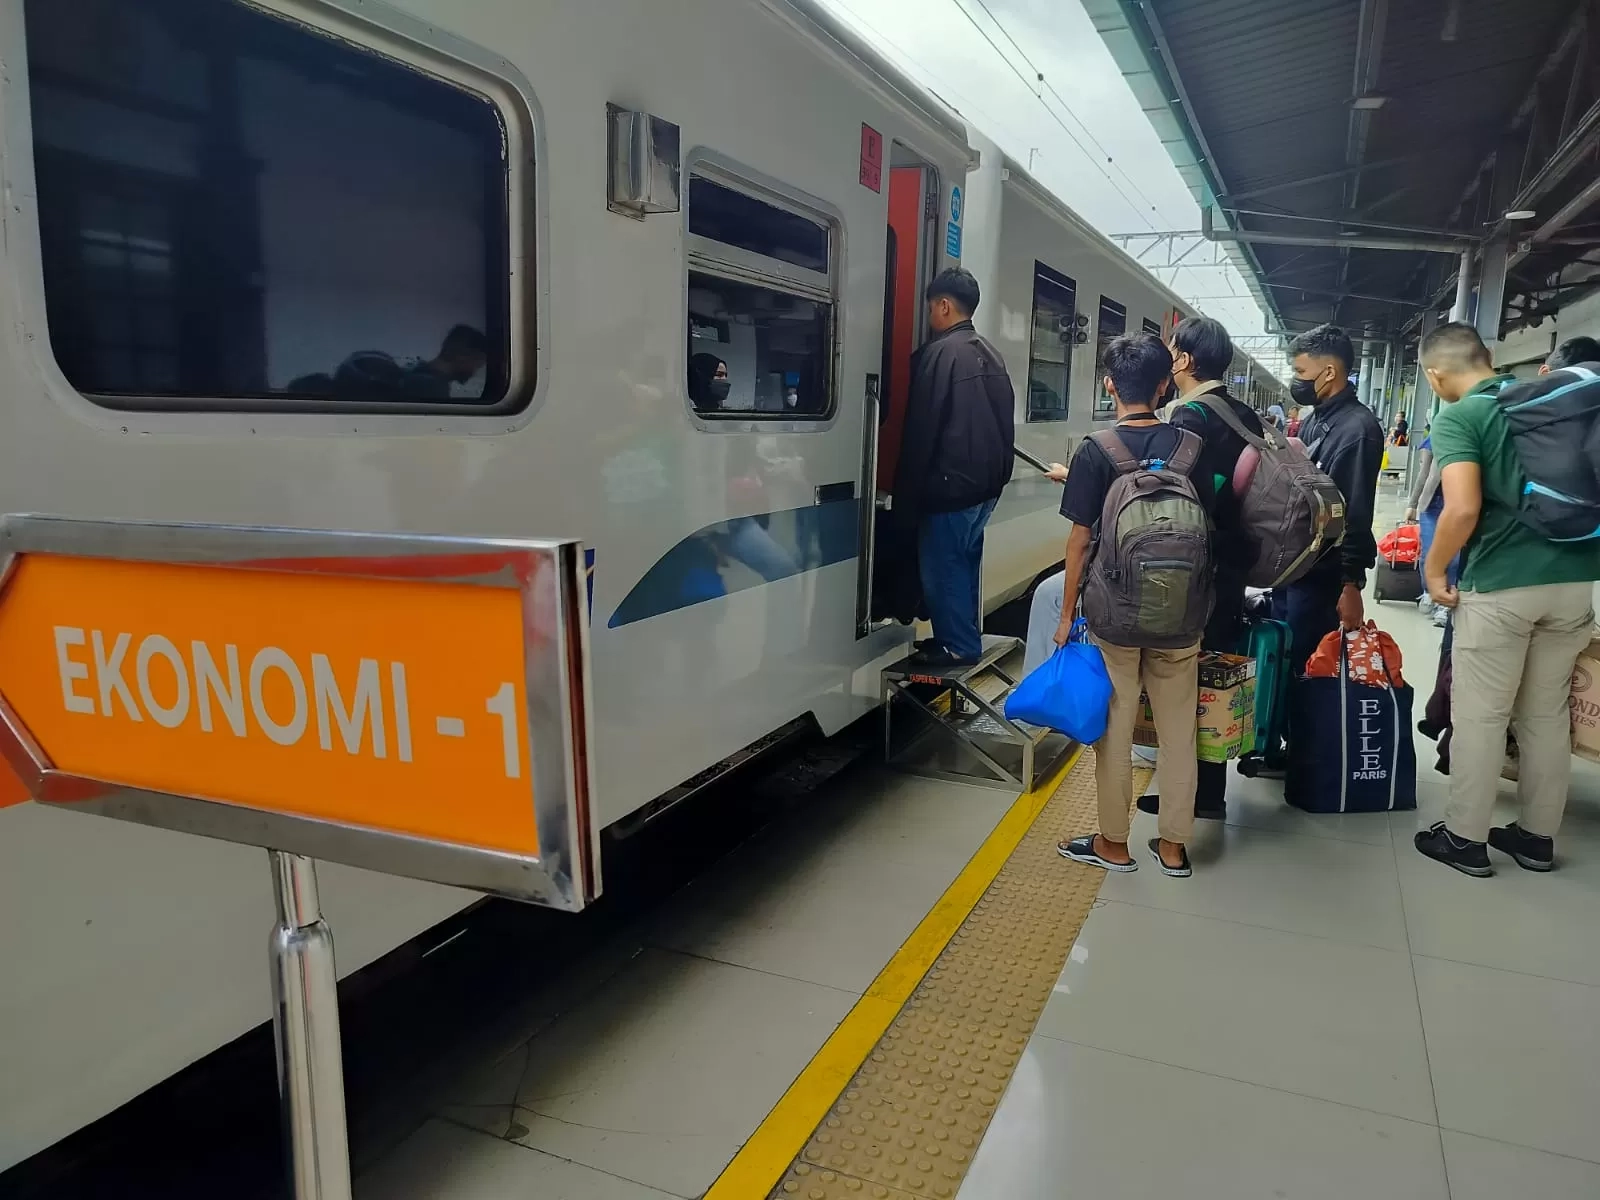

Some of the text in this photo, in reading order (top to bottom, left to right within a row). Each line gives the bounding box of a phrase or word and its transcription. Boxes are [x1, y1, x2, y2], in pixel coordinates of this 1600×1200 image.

[53, 625, 413, 763] EKONOMI
[486, 682, 520, 778] 1
[1567, 695, 1600, 718] OND
[1358, 699, 1381, 771] ELLE
[1352, 769, 1388, 780] PARIS
